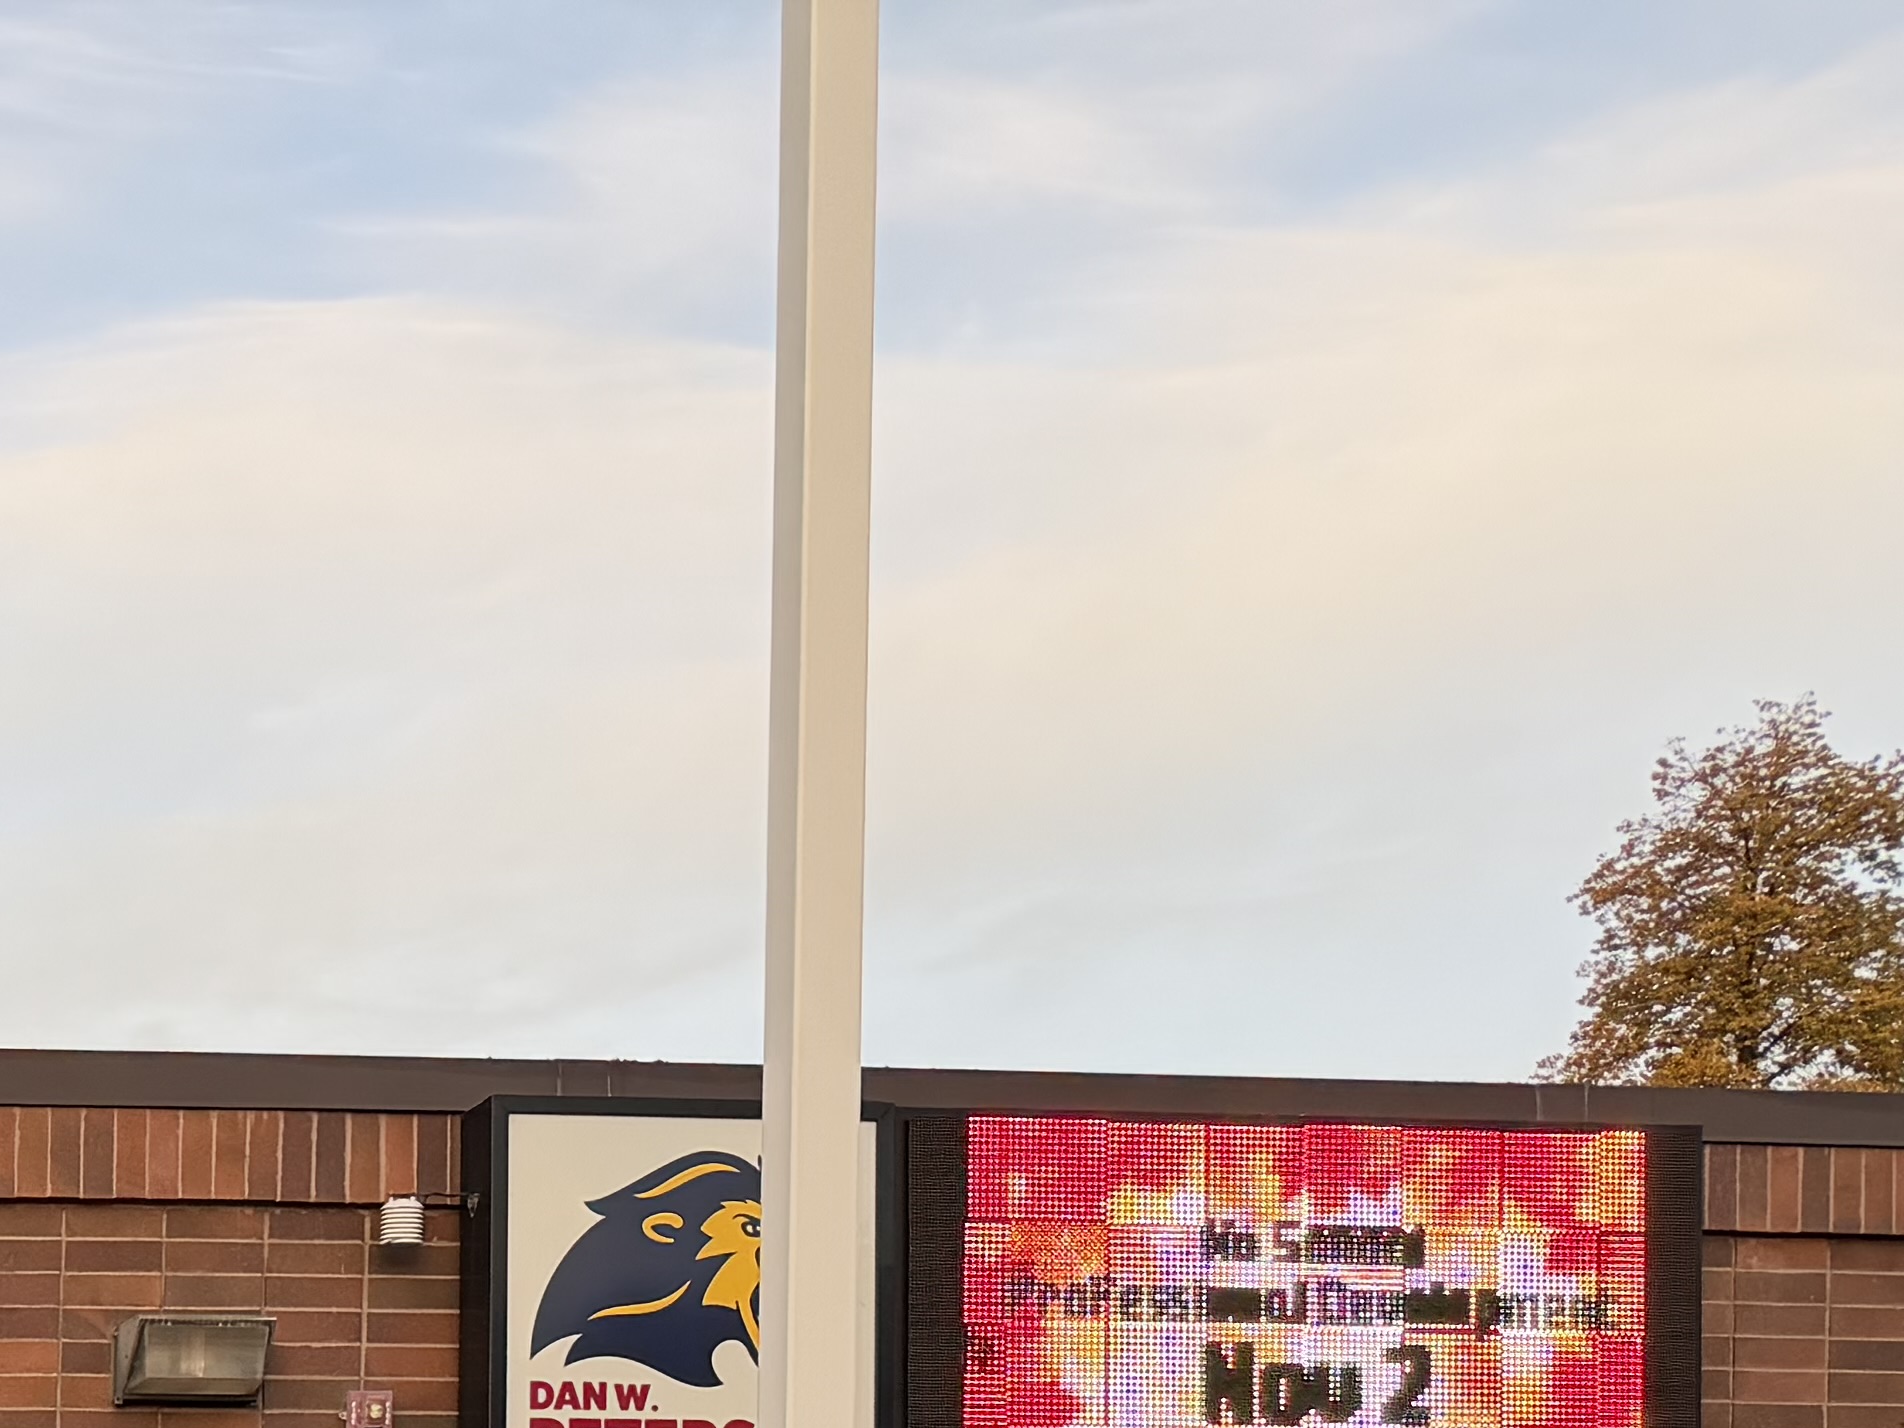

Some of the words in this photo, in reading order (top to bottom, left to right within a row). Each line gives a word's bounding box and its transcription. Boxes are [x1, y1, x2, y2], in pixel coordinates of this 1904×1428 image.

[1317, 1276, 1615, 1341] Devpment
[529, 1381, 607, 1411] DAN
[614, 1383, 659, 1411] W.
[1205, 1341, 1362, 1425] Nov
[1384, 1346, 1432, 1424] 2
